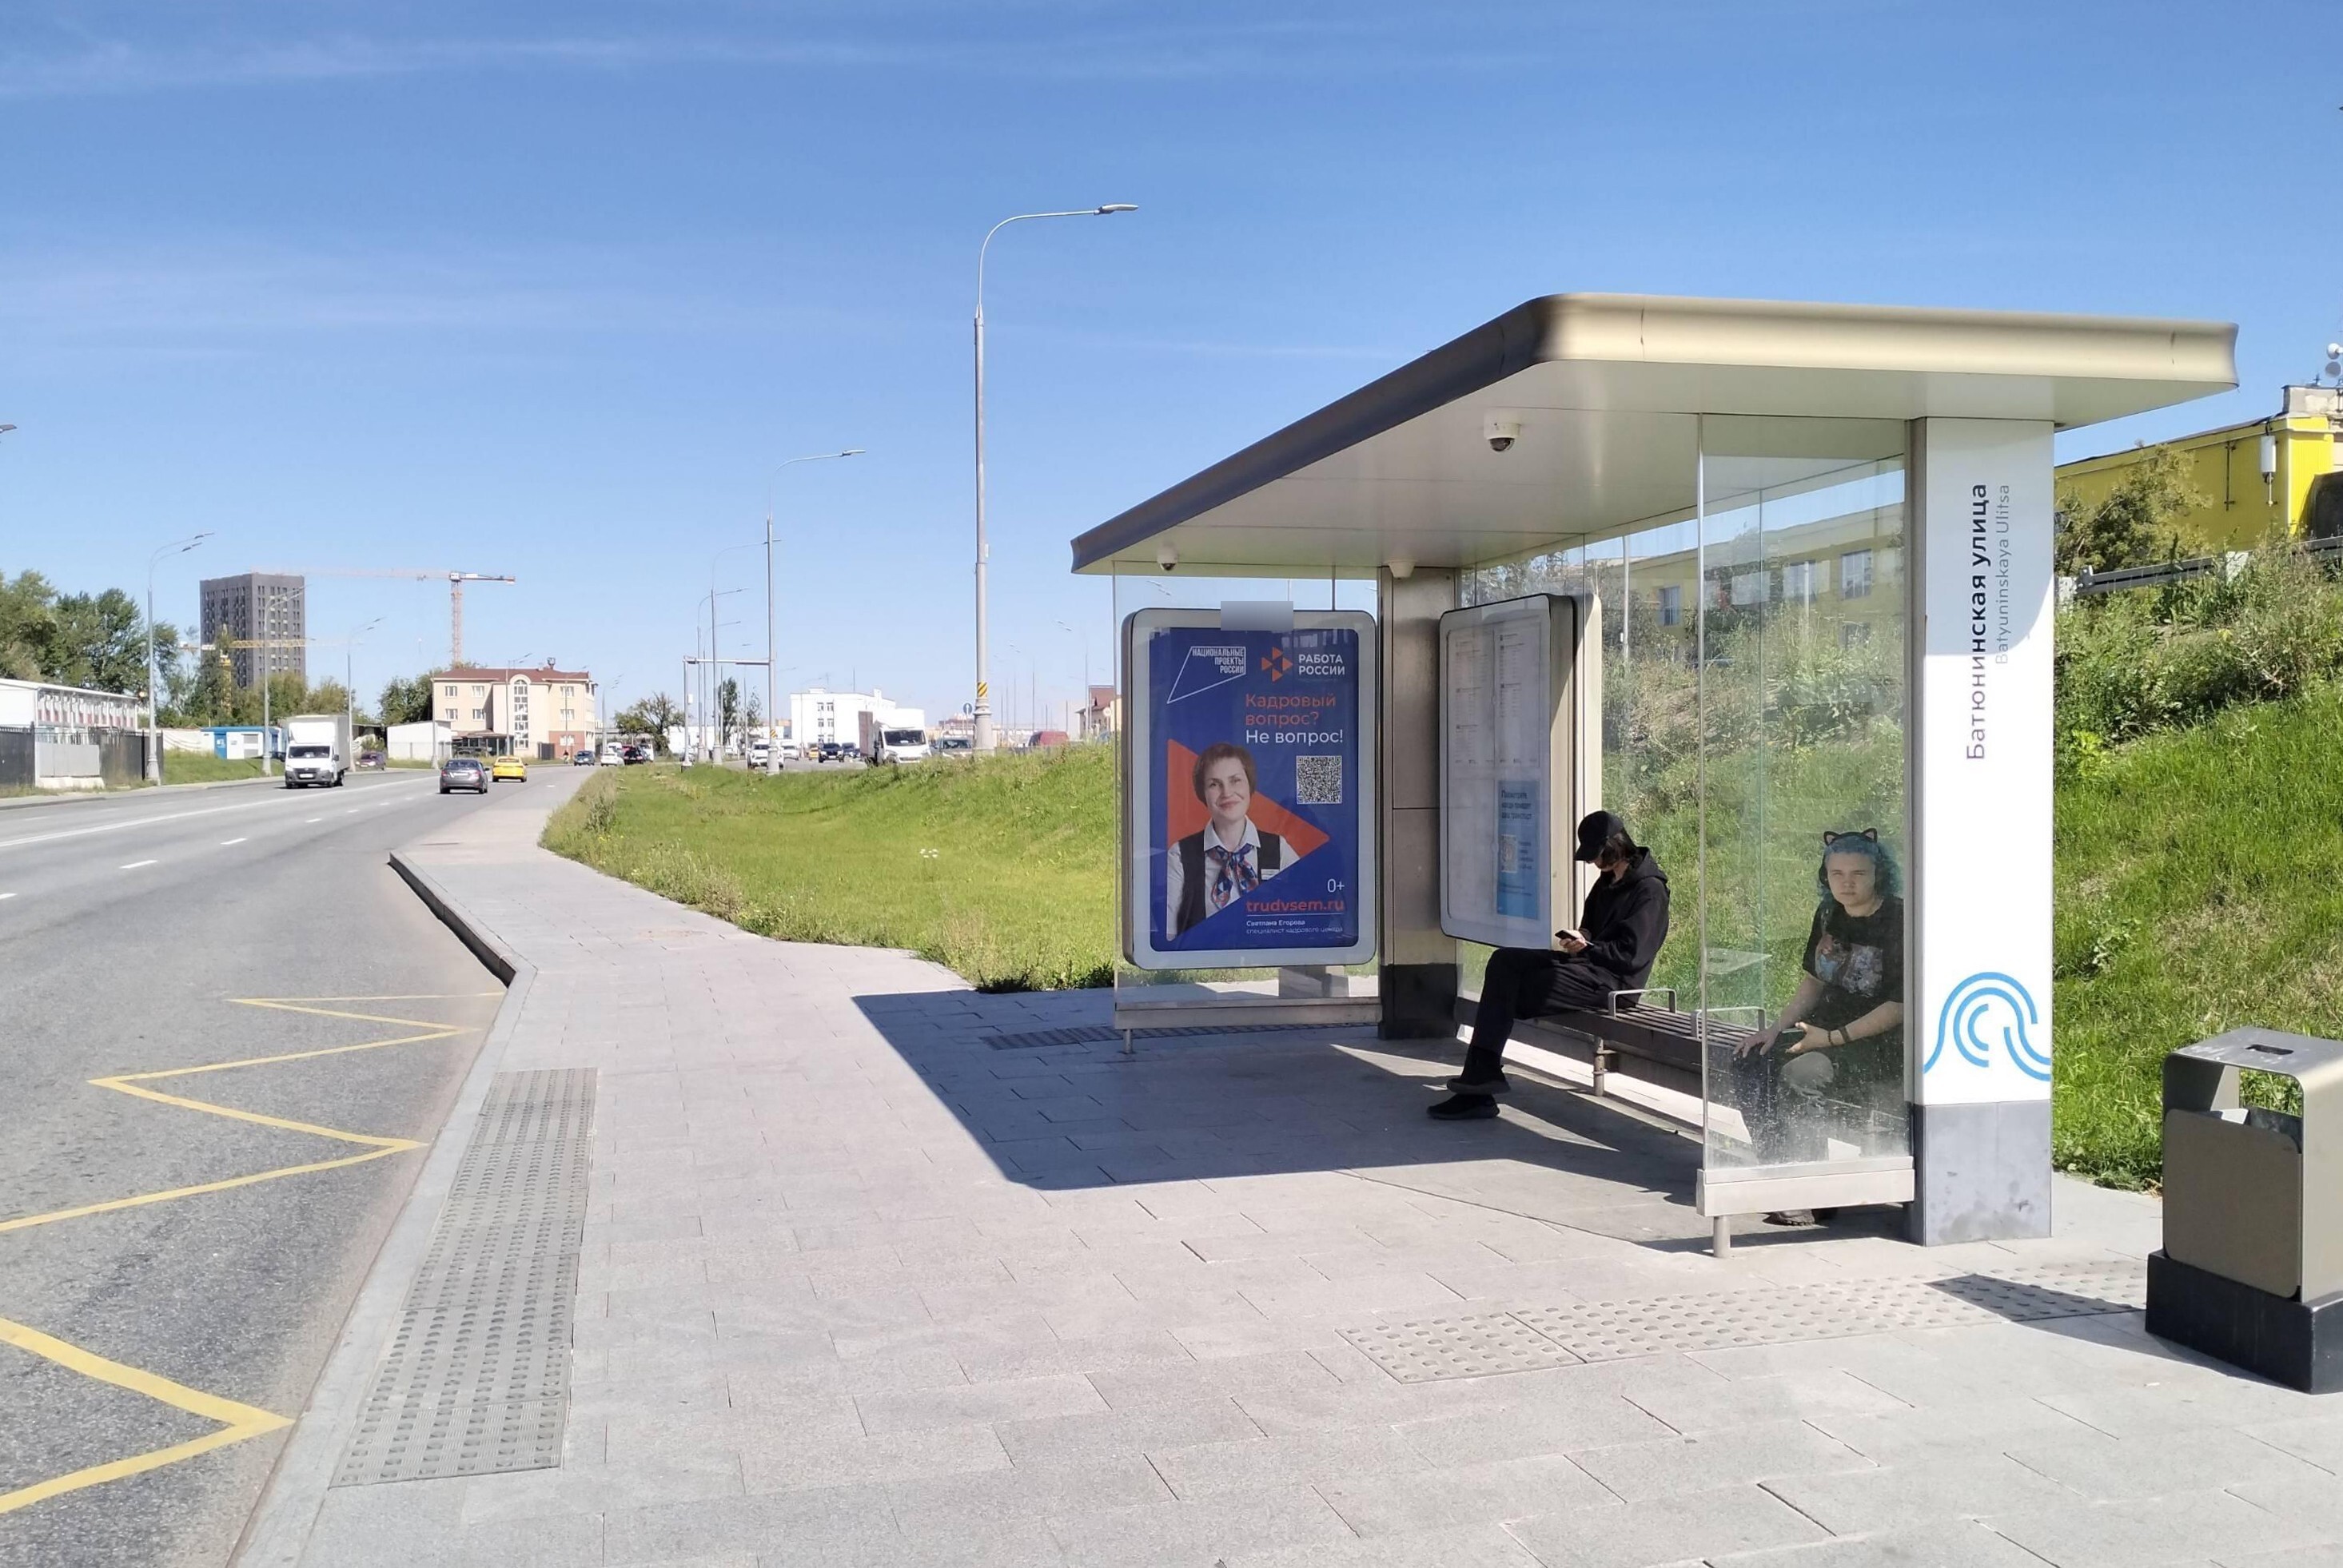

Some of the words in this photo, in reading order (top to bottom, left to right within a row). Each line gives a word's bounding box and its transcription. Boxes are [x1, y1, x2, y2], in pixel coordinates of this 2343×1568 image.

[1995, 485, 2010, 533] Ulitsa
[1971, 484, 1991, 567] улица
[1995, 539, 2013, 664] Batyuninskaya
[1192, 648, 1245, 657] НАЦИОНАЛЬНЫЕ
[1298, 654, 1343, 664] РАБОТА
[1220, 665, 1245, 674] РОССИИ
[1298, 665, 1345, 675] РОССИИ
[1966, 575, 1986, 760] Батюнинская
[1245, 694, 1336, 709] Кадровый
[1245, 711, 1320, 728] вопрос?
[1245, 729, 1270, 744] Не
[1275, 729, 1344, 746] вопрос!
[1327, 878, 1345, 892] 0+
[1246, 899, 1344, 912] trudvsem.ru
